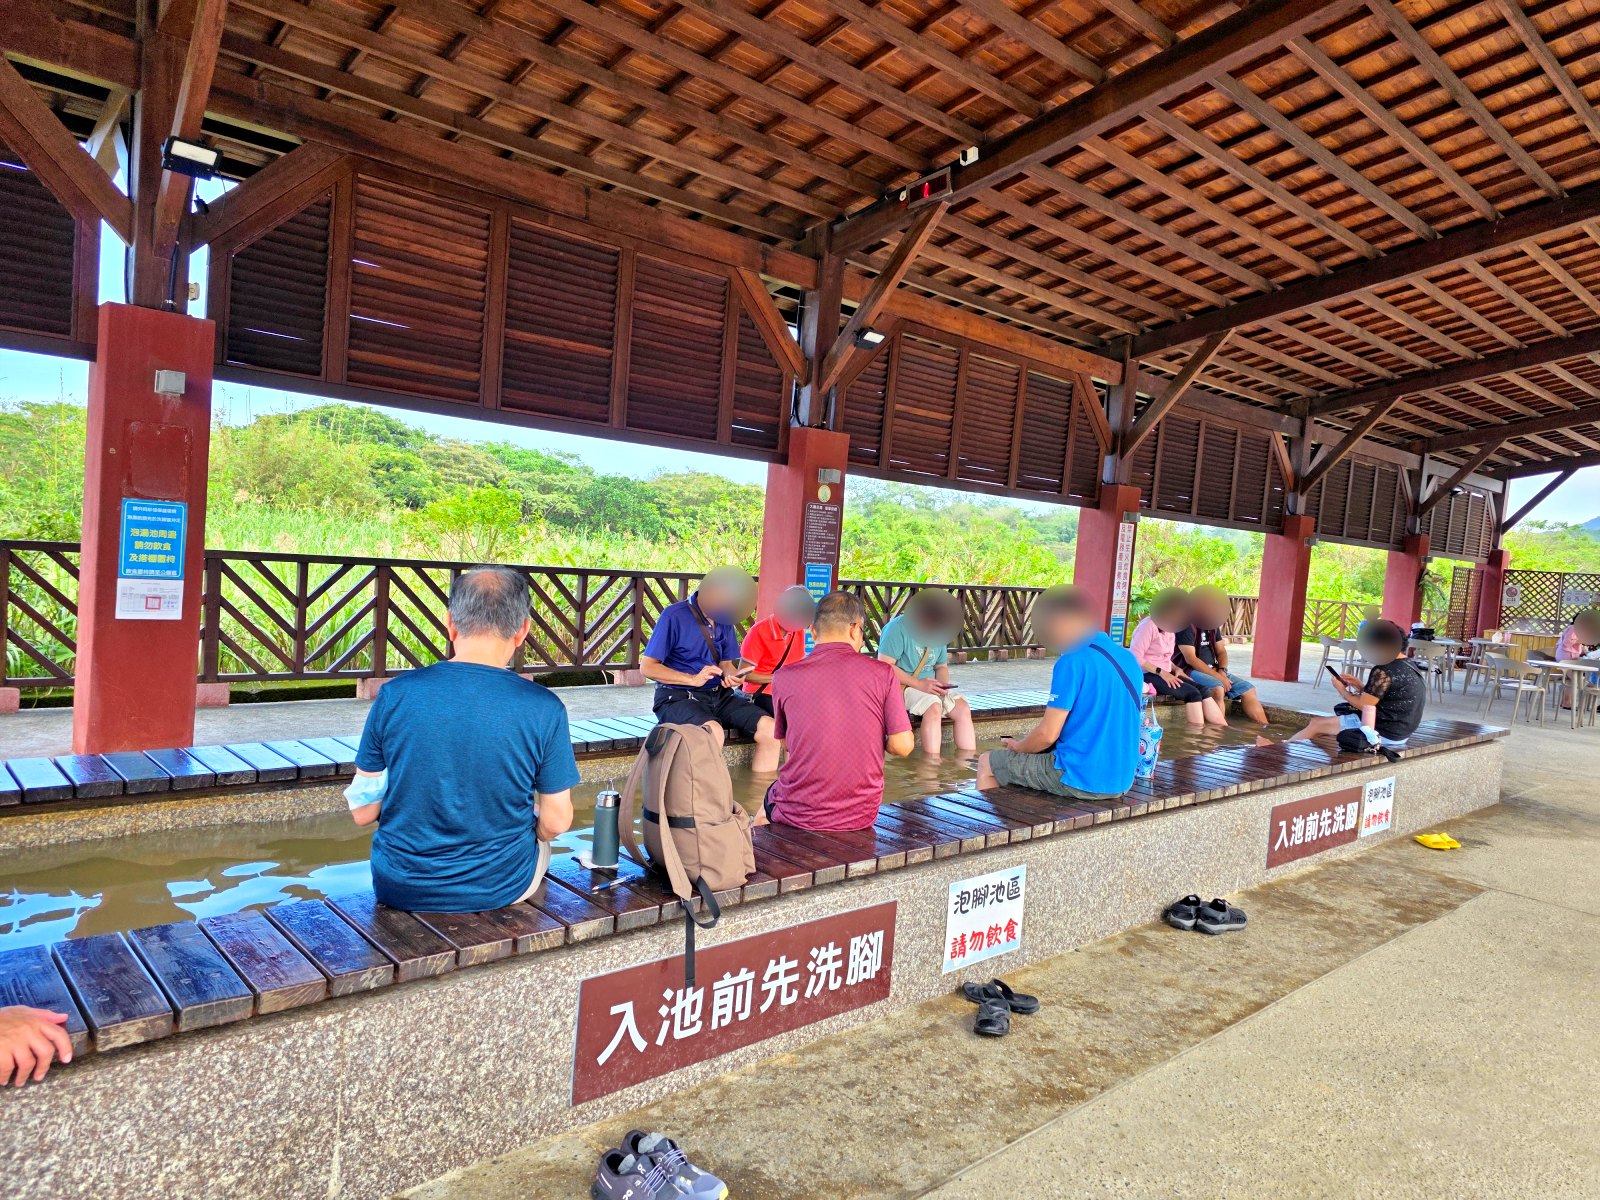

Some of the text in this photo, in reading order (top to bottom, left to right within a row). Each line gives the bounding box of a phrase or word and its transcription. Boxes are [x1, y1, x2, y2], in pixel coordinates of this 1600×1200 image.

[134, 540, 171, 551] 請勿飲食
[1366, 782, 1393, 803] 泡腳池區
[1274, 801, 1359, 852] 入池前先洗腳
[1364, 808, 1391, 829] 請勿飲食
[953, 875, 1021, 915] 泡腳池區
[950, 917, 1019, 960] 請勿飲食
[596, 929, 885, 1067] 入池前先洗腳
